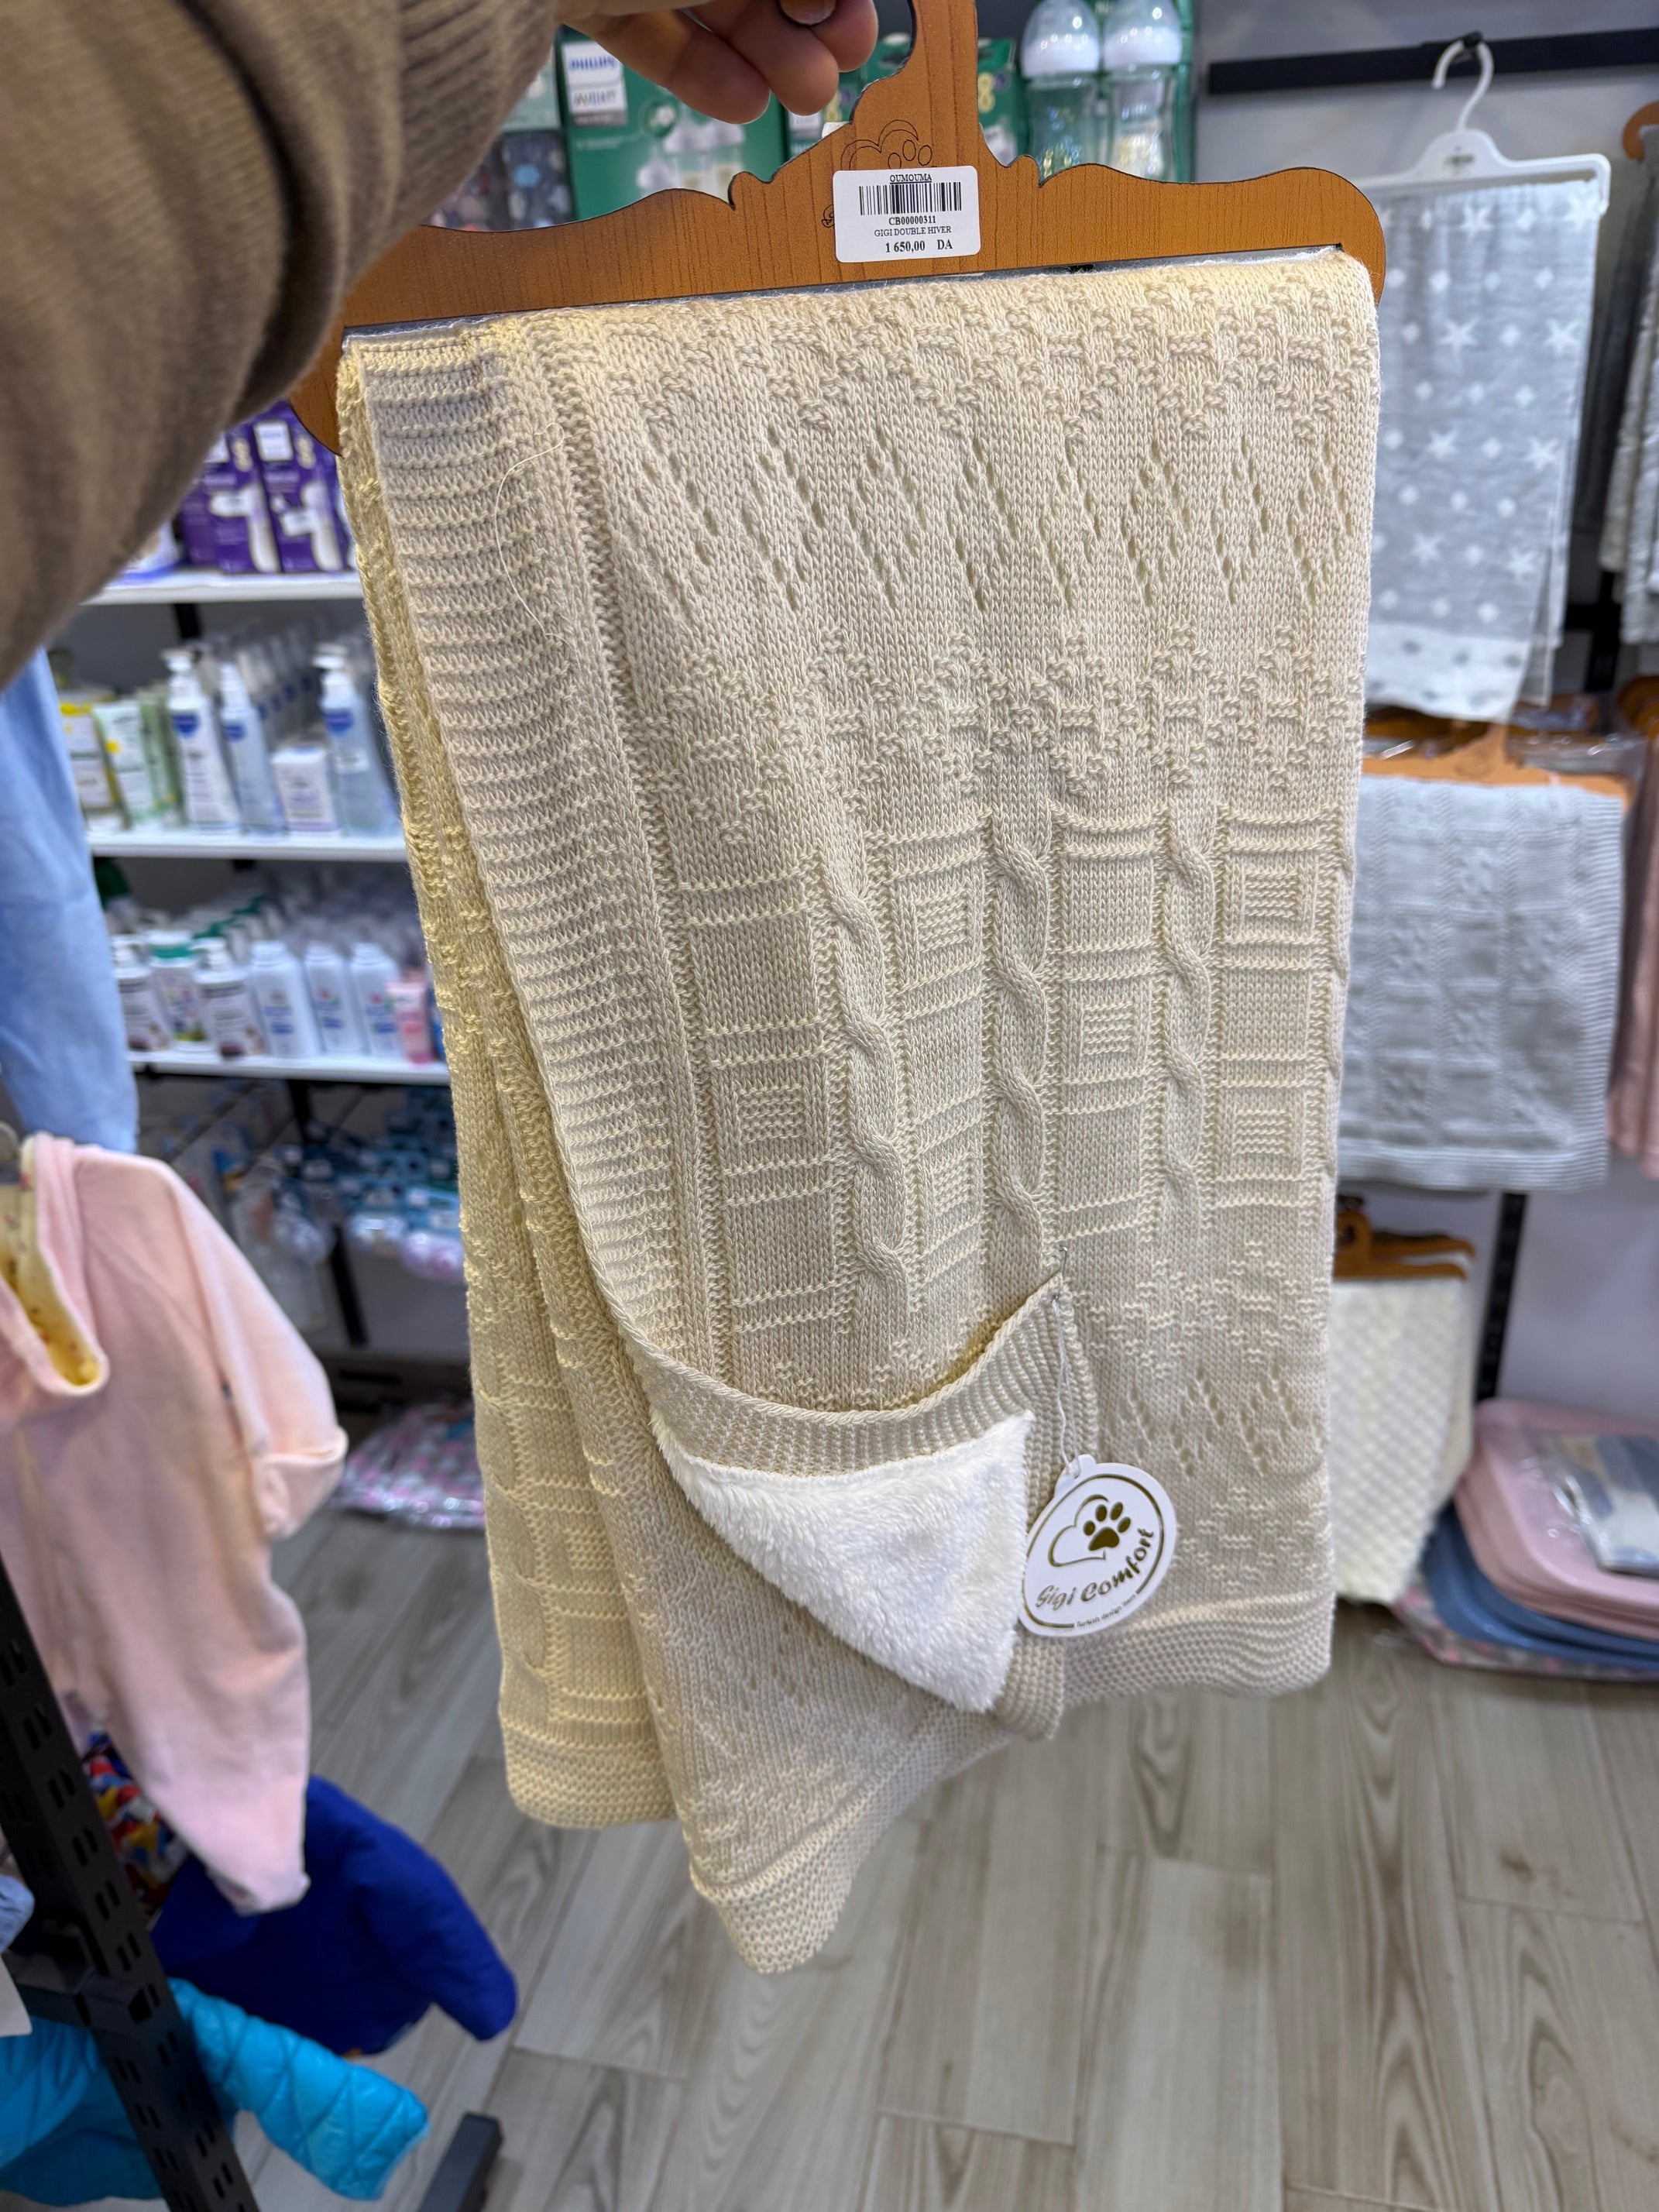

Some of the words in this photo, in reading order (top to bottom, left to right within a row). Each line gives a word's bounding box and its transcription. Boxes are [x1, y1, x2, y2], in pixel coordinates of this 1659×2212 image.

[890, 173, 932, 183] OUMOUMA
[888, 215, 936, 225] CB00000311
[894, 227, 926, 236] DOUBLE
[928, 225, 952, 235] HIVER
[937, 239, 953, 249] DA
[1080, 1528, 1154, 1602] Comfort
